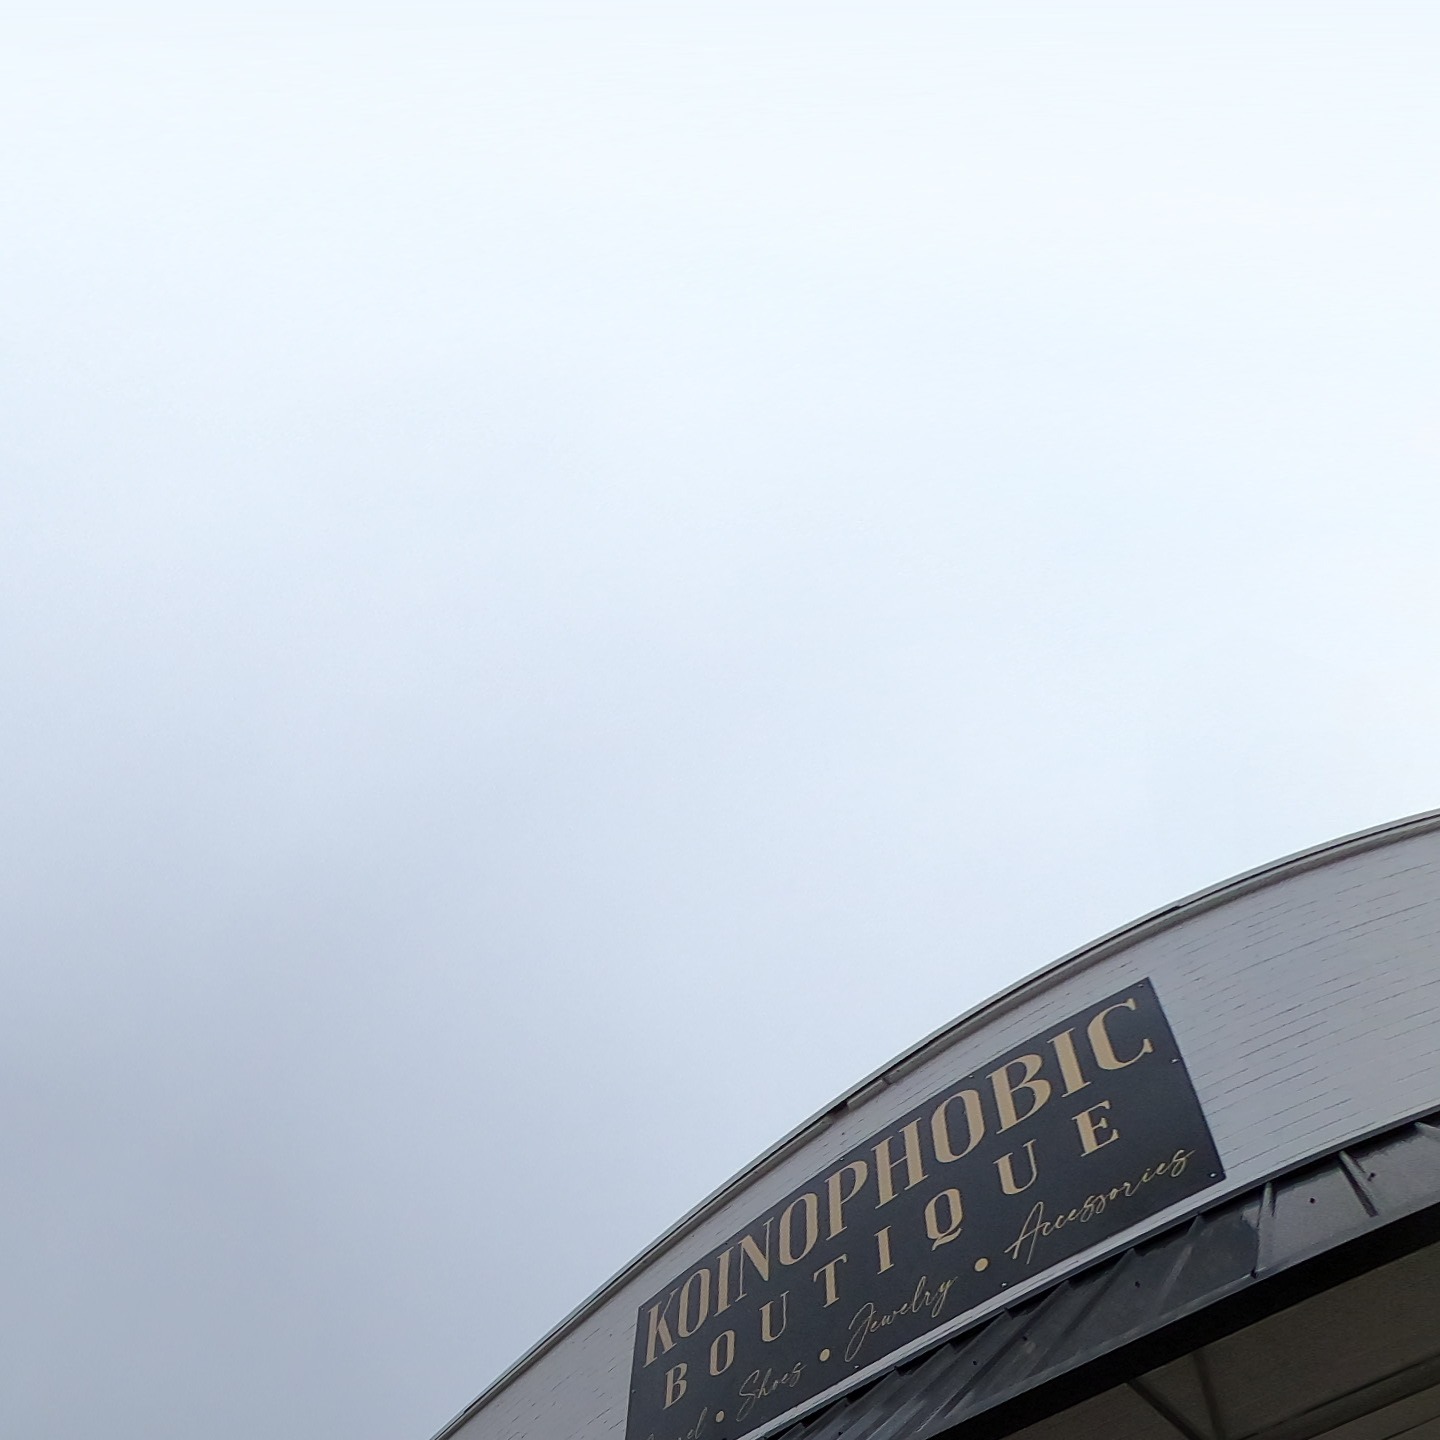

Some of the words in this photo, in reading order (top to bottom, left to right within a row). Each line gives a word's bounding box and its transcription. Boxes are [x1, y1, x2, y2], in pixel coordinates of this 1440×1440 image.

[642, 997, 1155, 1368] KOINOPHOBIC
[663, 1099, 1120, 1409] BOUTIQUE
[735, 1362, 806, 1423] Shoes
[844, 1275, 959, 1363] Jewelry
[1004, 1147, 1197, 1265] Accessories
